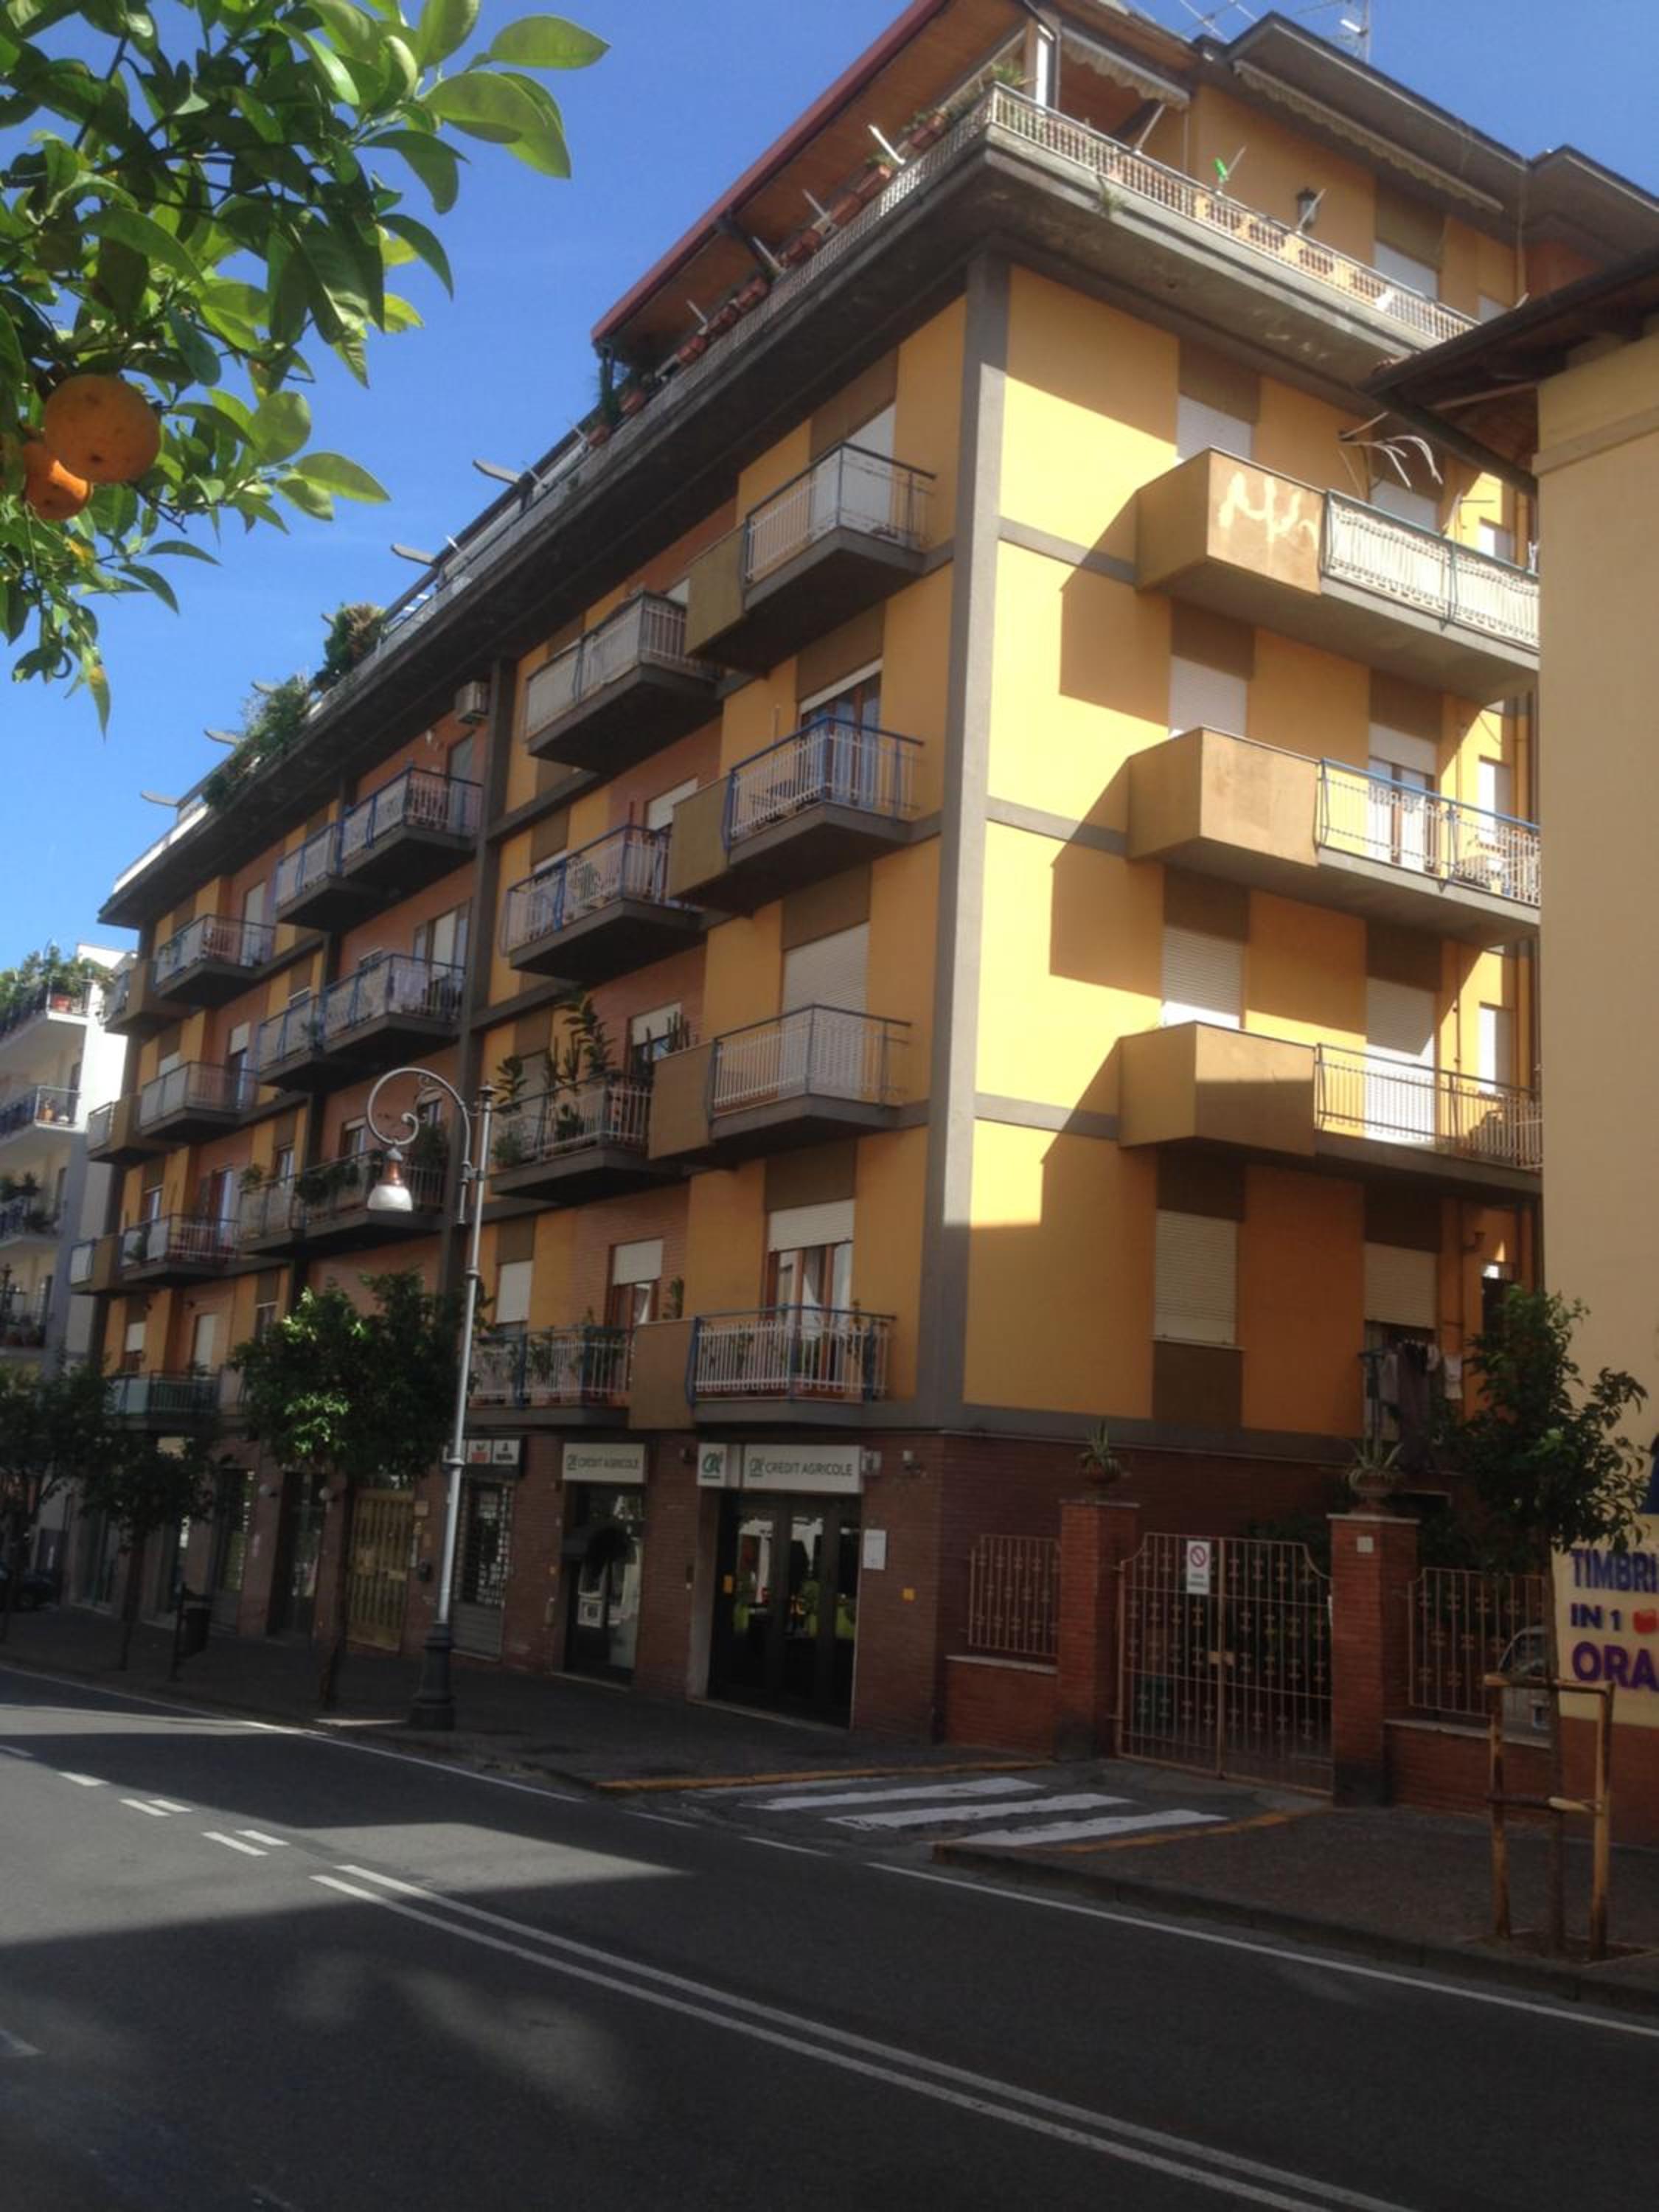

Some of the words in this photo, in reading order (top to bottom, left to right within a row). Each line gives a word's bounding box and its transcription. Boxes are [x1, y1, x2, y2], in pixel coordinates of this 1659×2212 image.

[801, 1461, 852, 1476] AGRICOLE
[1570, 1549, 1659, 1593] TIMBRI
[1571, 1603, 1602, 1629] IN
[1610, 1609, 1622, 1630] 1
[1572, 1641, 1659, 1691] ORA
